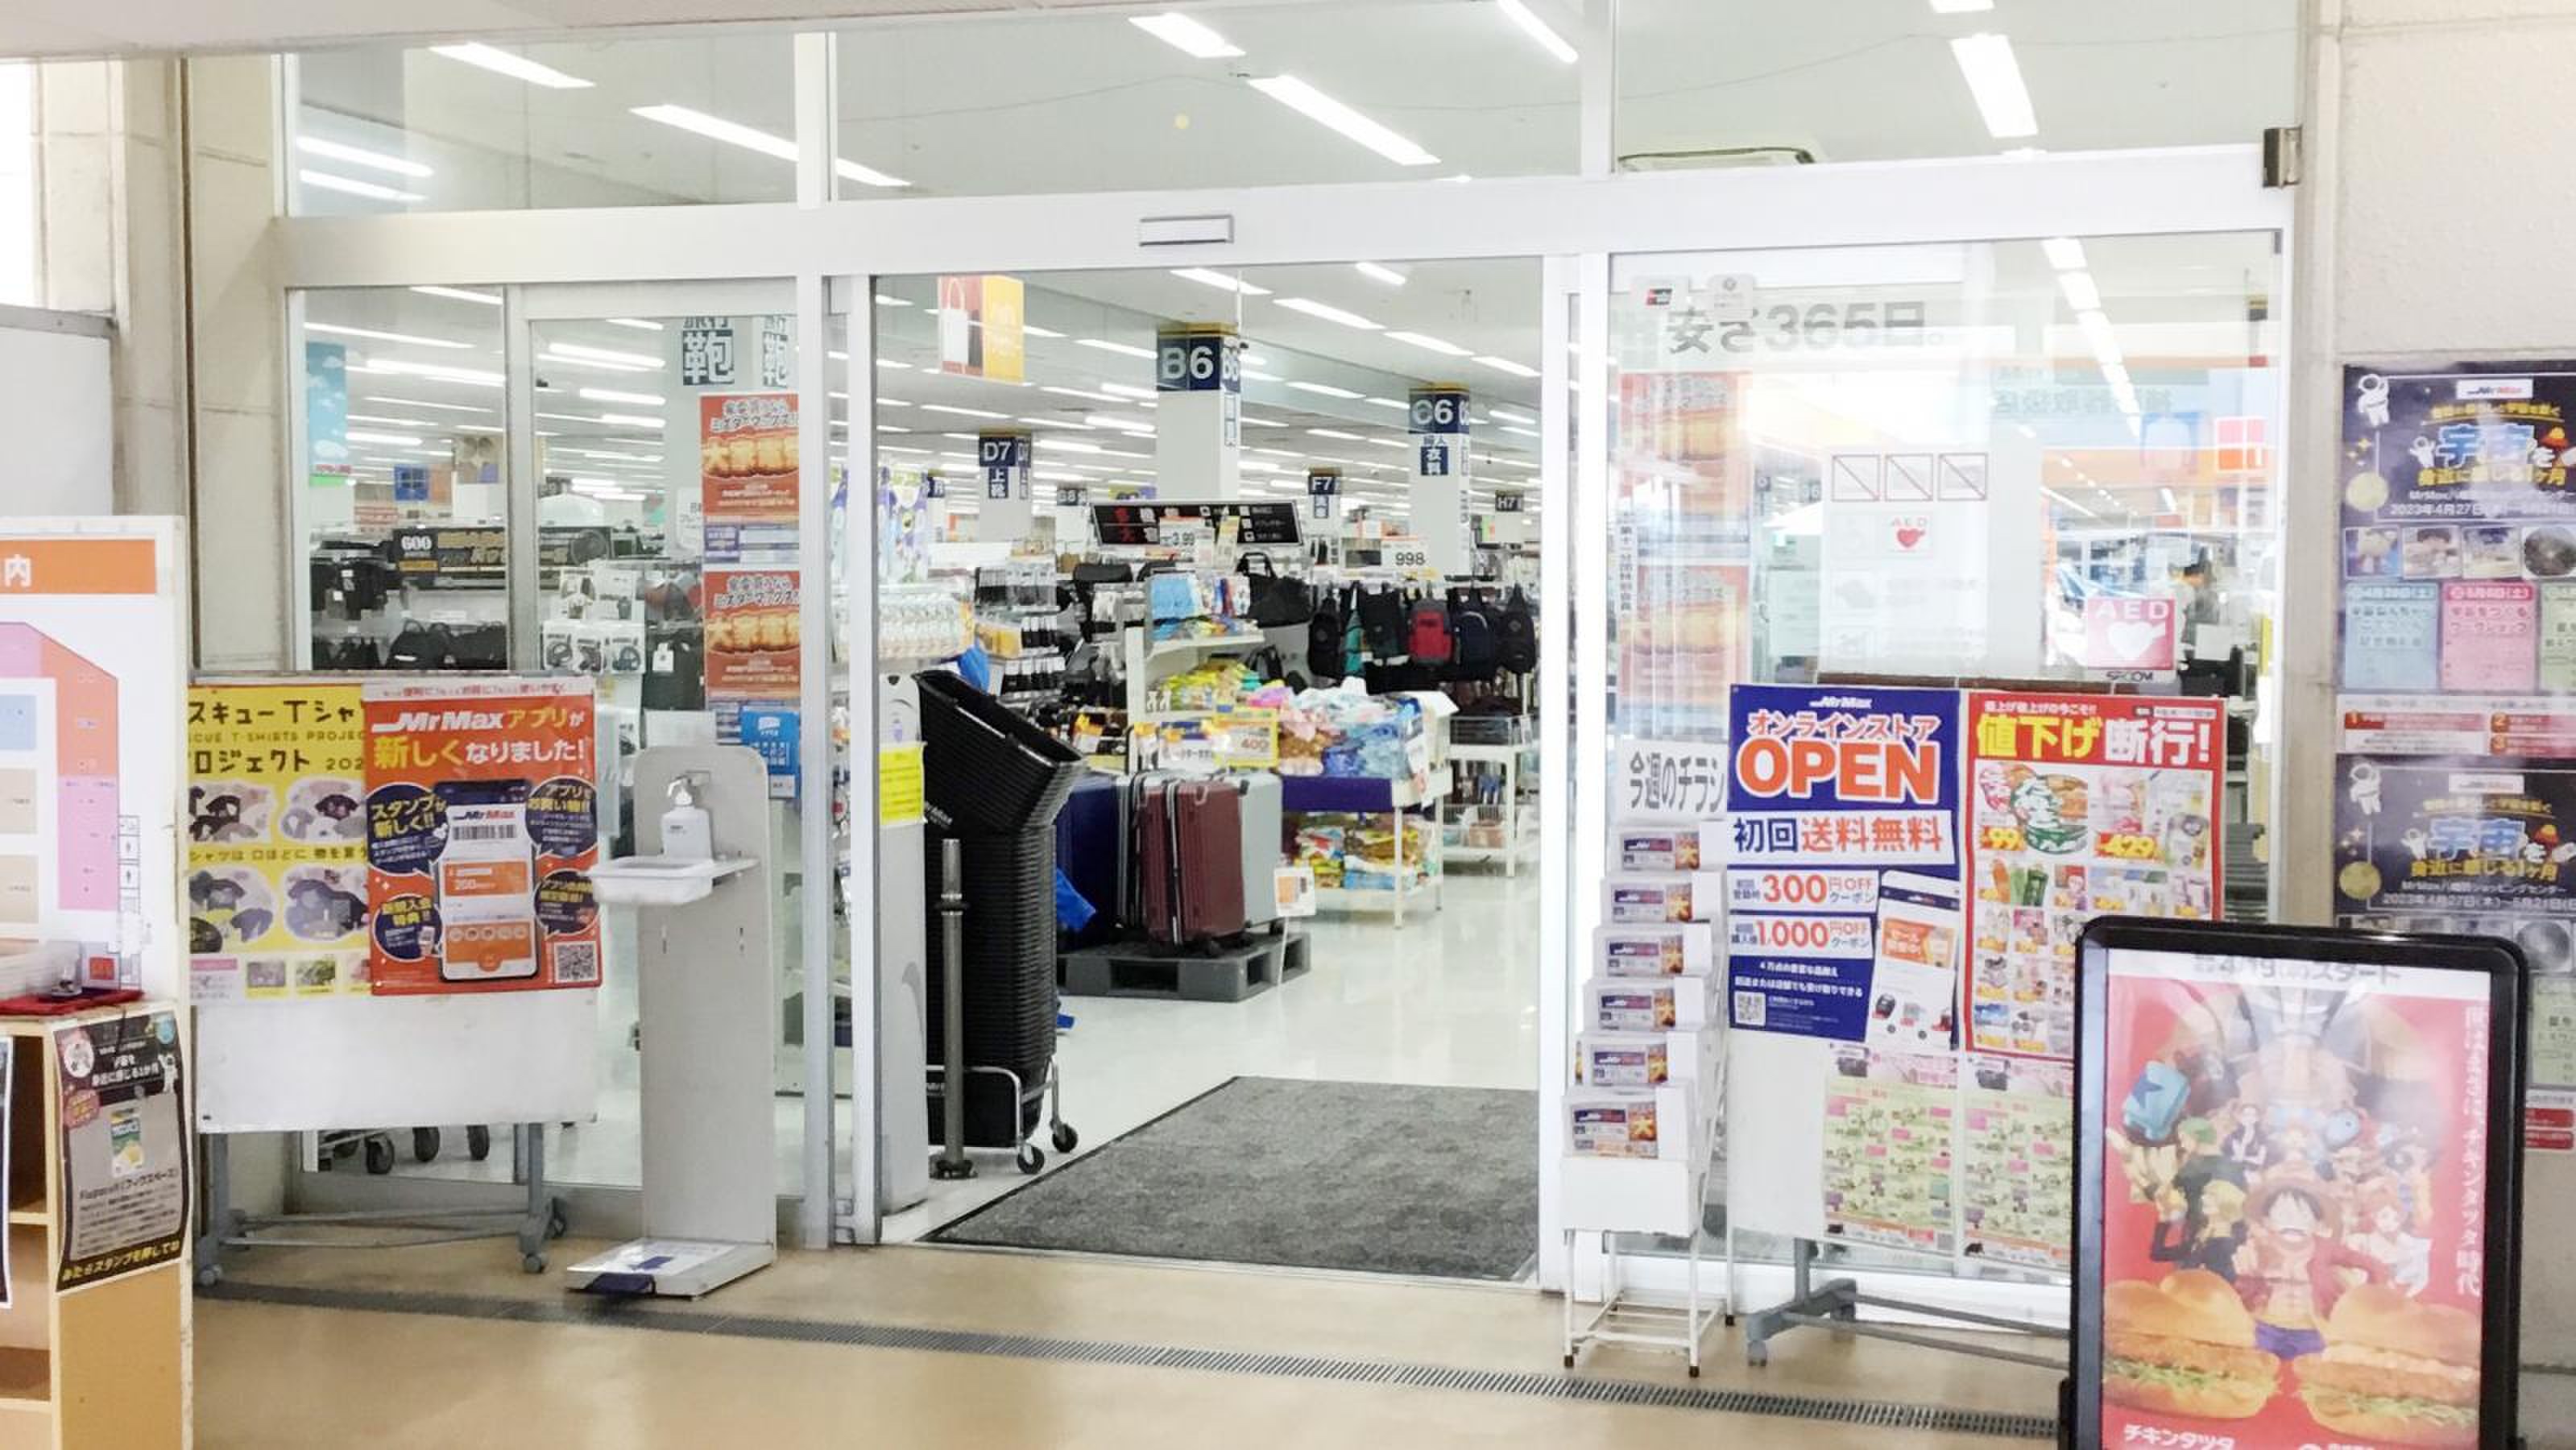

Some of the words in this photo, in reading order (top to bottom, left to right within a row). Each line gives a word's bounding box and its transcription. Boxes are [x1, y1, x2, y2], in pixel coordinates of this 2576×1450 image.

[1162, 346, 1214, 379] B6
[1411, 399, 1453, 425] C6
[984, 441, 1012, 462] D7
[5, 553, 31, 587] 内
[1395, 552, 1426, 566] 998
[188, 700, 362, 724] スキューTシャ
[1746, 708, 1941, 741] オンラインストア
[373, 735, 585, 769] 新しくなりました!
[1977, 713, 2210, 765] 値下げ断行!
[188, 749, 310, 773] ロジェクト
[1736, 736, 1940, 805] OPEN
[1629, 751, 1725, 813] 今週のチラシ
[1733, 817, 1943, 853] 初回送料無料
[1762, 873, 1828, 904] 300
[1829, 892, 1875, 904] クーポン
[2123, 1423, 2236, 1450] チキンタツタ
